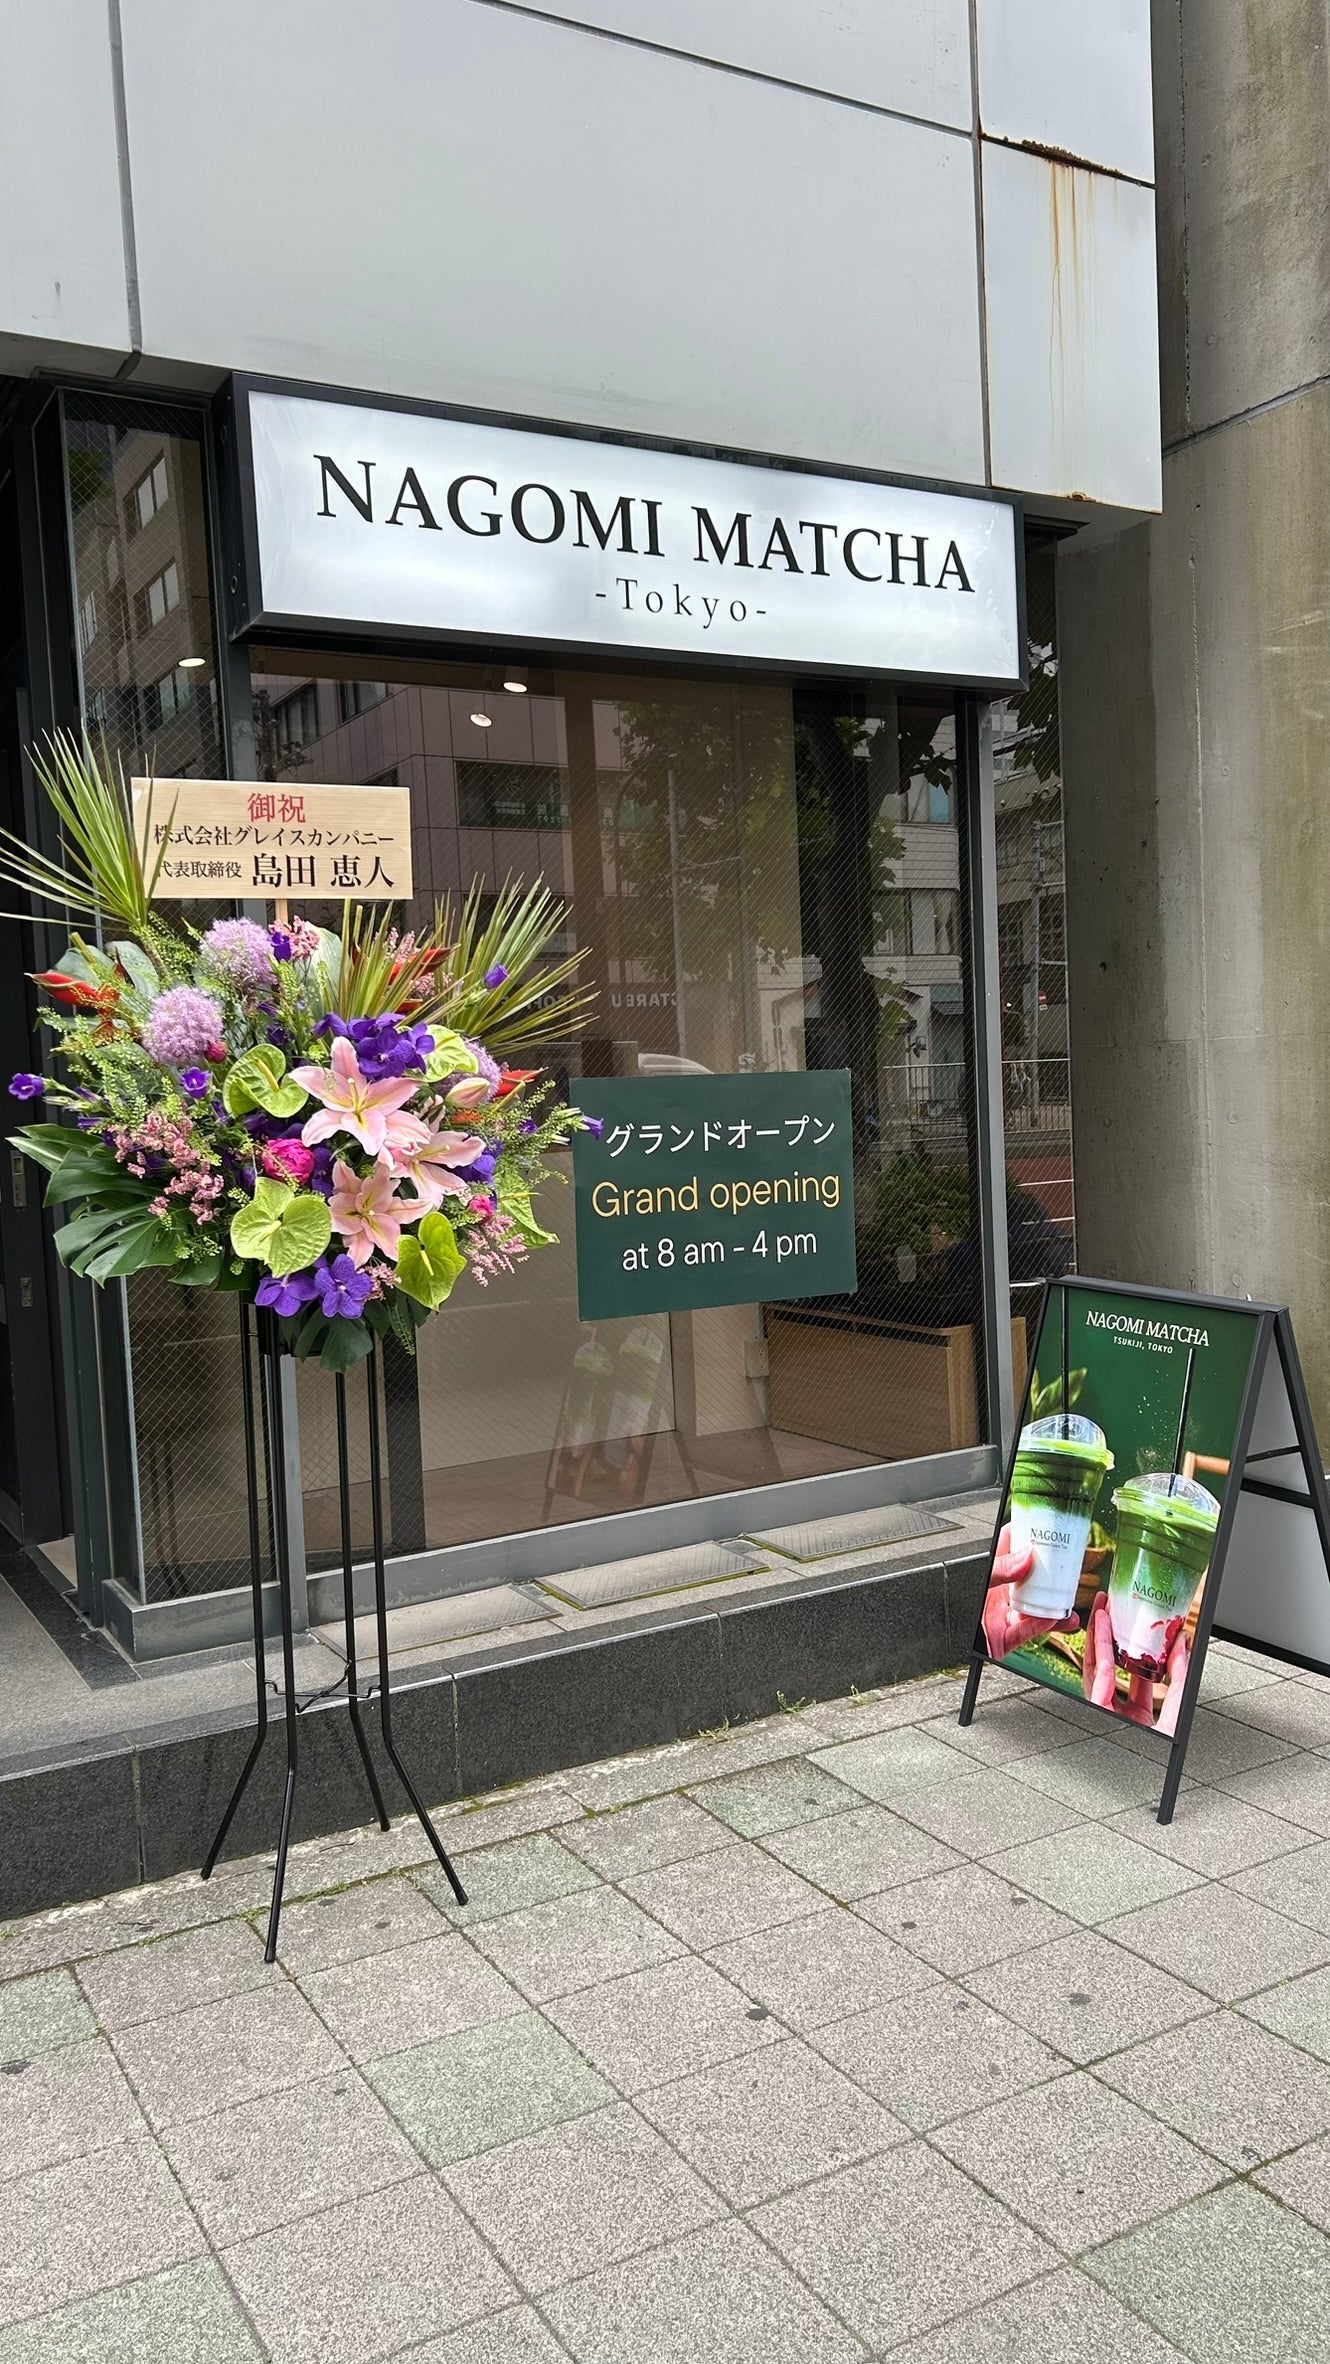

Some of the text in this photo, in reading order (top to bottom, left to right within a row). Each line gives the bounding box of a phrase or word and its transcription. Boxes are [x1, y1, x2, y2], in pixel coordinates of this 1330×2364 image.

[313, 454, 976, 593] NAGOMI MATCHA
[595, 578, 768, 630] -Tokyo-
[247, 792, 306, 823] 御祝
[154, 824, 395, 847] 株式会社グレイスカンパニー
[157, 852, 395, 888] 代表取締役 島田 恵人
[605, 1114, 835, 1158] グランドオープン
[591, 1170, 841, 1218] Grand opening
[621, 1242, 650, 1271] at
[656, 1237, 675, 1268] 8
[683, 1240, 725, 1265] am
[751, 1229, 768, 1258] 4
[775, 1231, 817, 1263] pm
[1085, 1310, 1210, 1346] NAGOMI MATCHA
[1112, 1335, 1174, 1354] TSUKIJI, TOKYO
[1030, 1527, 1071, 1544] NAGOMI
[1132, 1580, 1177, 1607] NAGOMI
